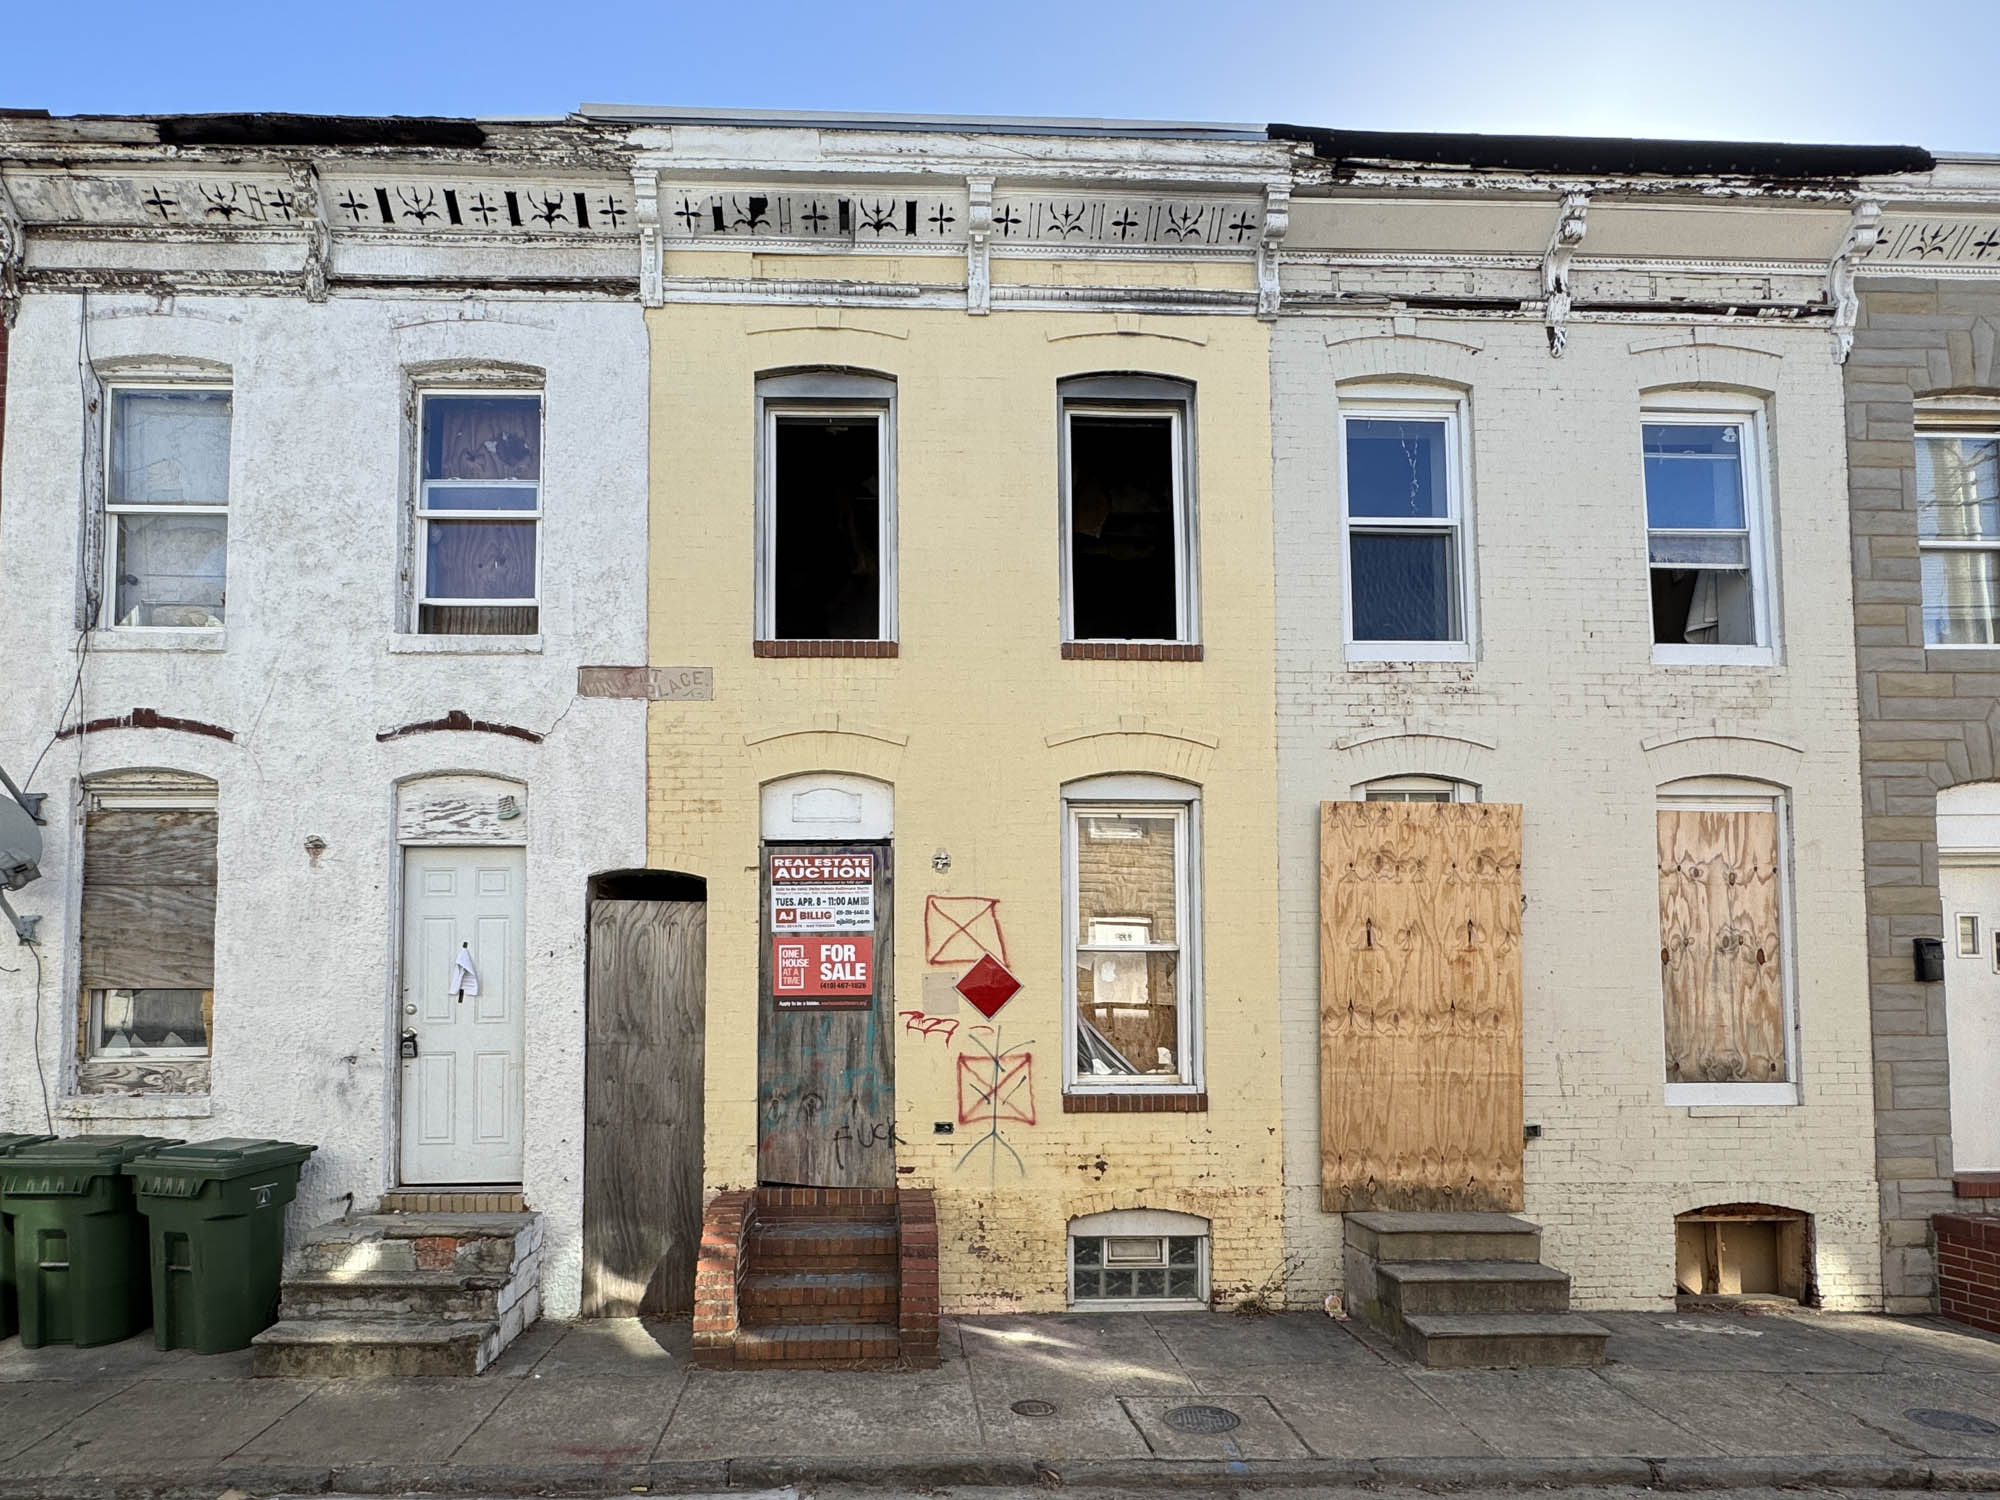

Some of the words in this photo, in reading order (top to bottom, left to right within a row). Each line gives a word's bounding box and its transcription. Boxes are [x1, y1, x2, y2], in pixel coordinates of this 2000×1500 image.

[775, 867, 870, 878] AUCTION
[775, 897, 796, 906] TUES.
[798, 897, 816, 906] APR.
[816, 897, 821, 905] 8
[828, 896, 846, 905] 11:00
[847, 896, 860, 905] AM
[778, 912, 794, 921] AJ
[800, 911, 832, 920] BILLIG
[783, 950, 800, 958] ONE
[820, 944, 856, 962] FOR
[783, 959, 809, 967] HOUSE
[820, 963, 866, 980] SALE
